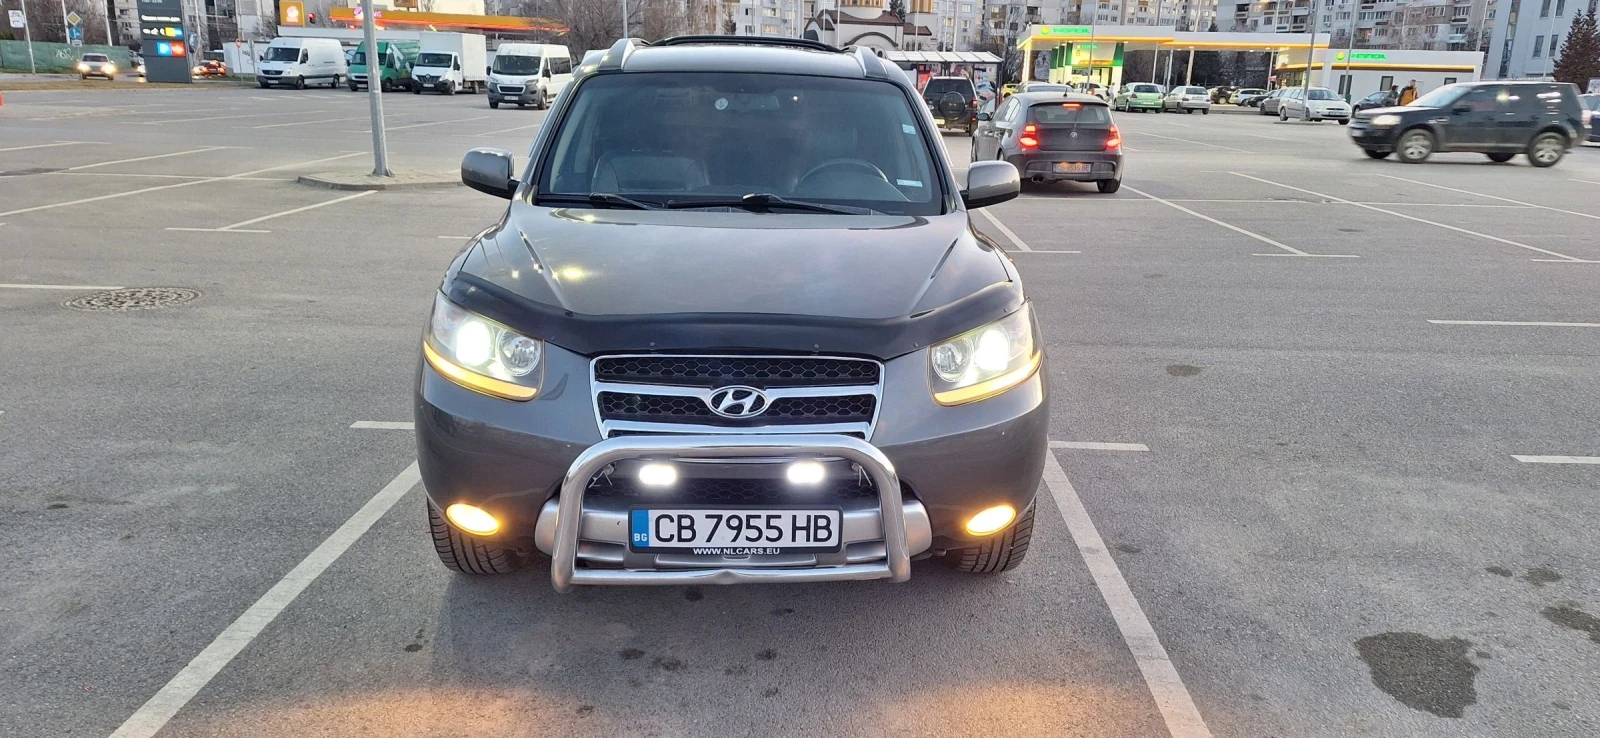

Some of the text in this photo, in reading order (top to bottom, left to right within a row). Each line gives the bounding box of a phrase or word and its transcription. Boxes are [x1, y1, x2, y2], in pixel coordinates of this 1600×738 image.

[654, 514, 833, 543] CB 7955 HB
[633, 533, 648, 542] BG
[692, 547, 780, 556] WWW.NLCARS.EU
